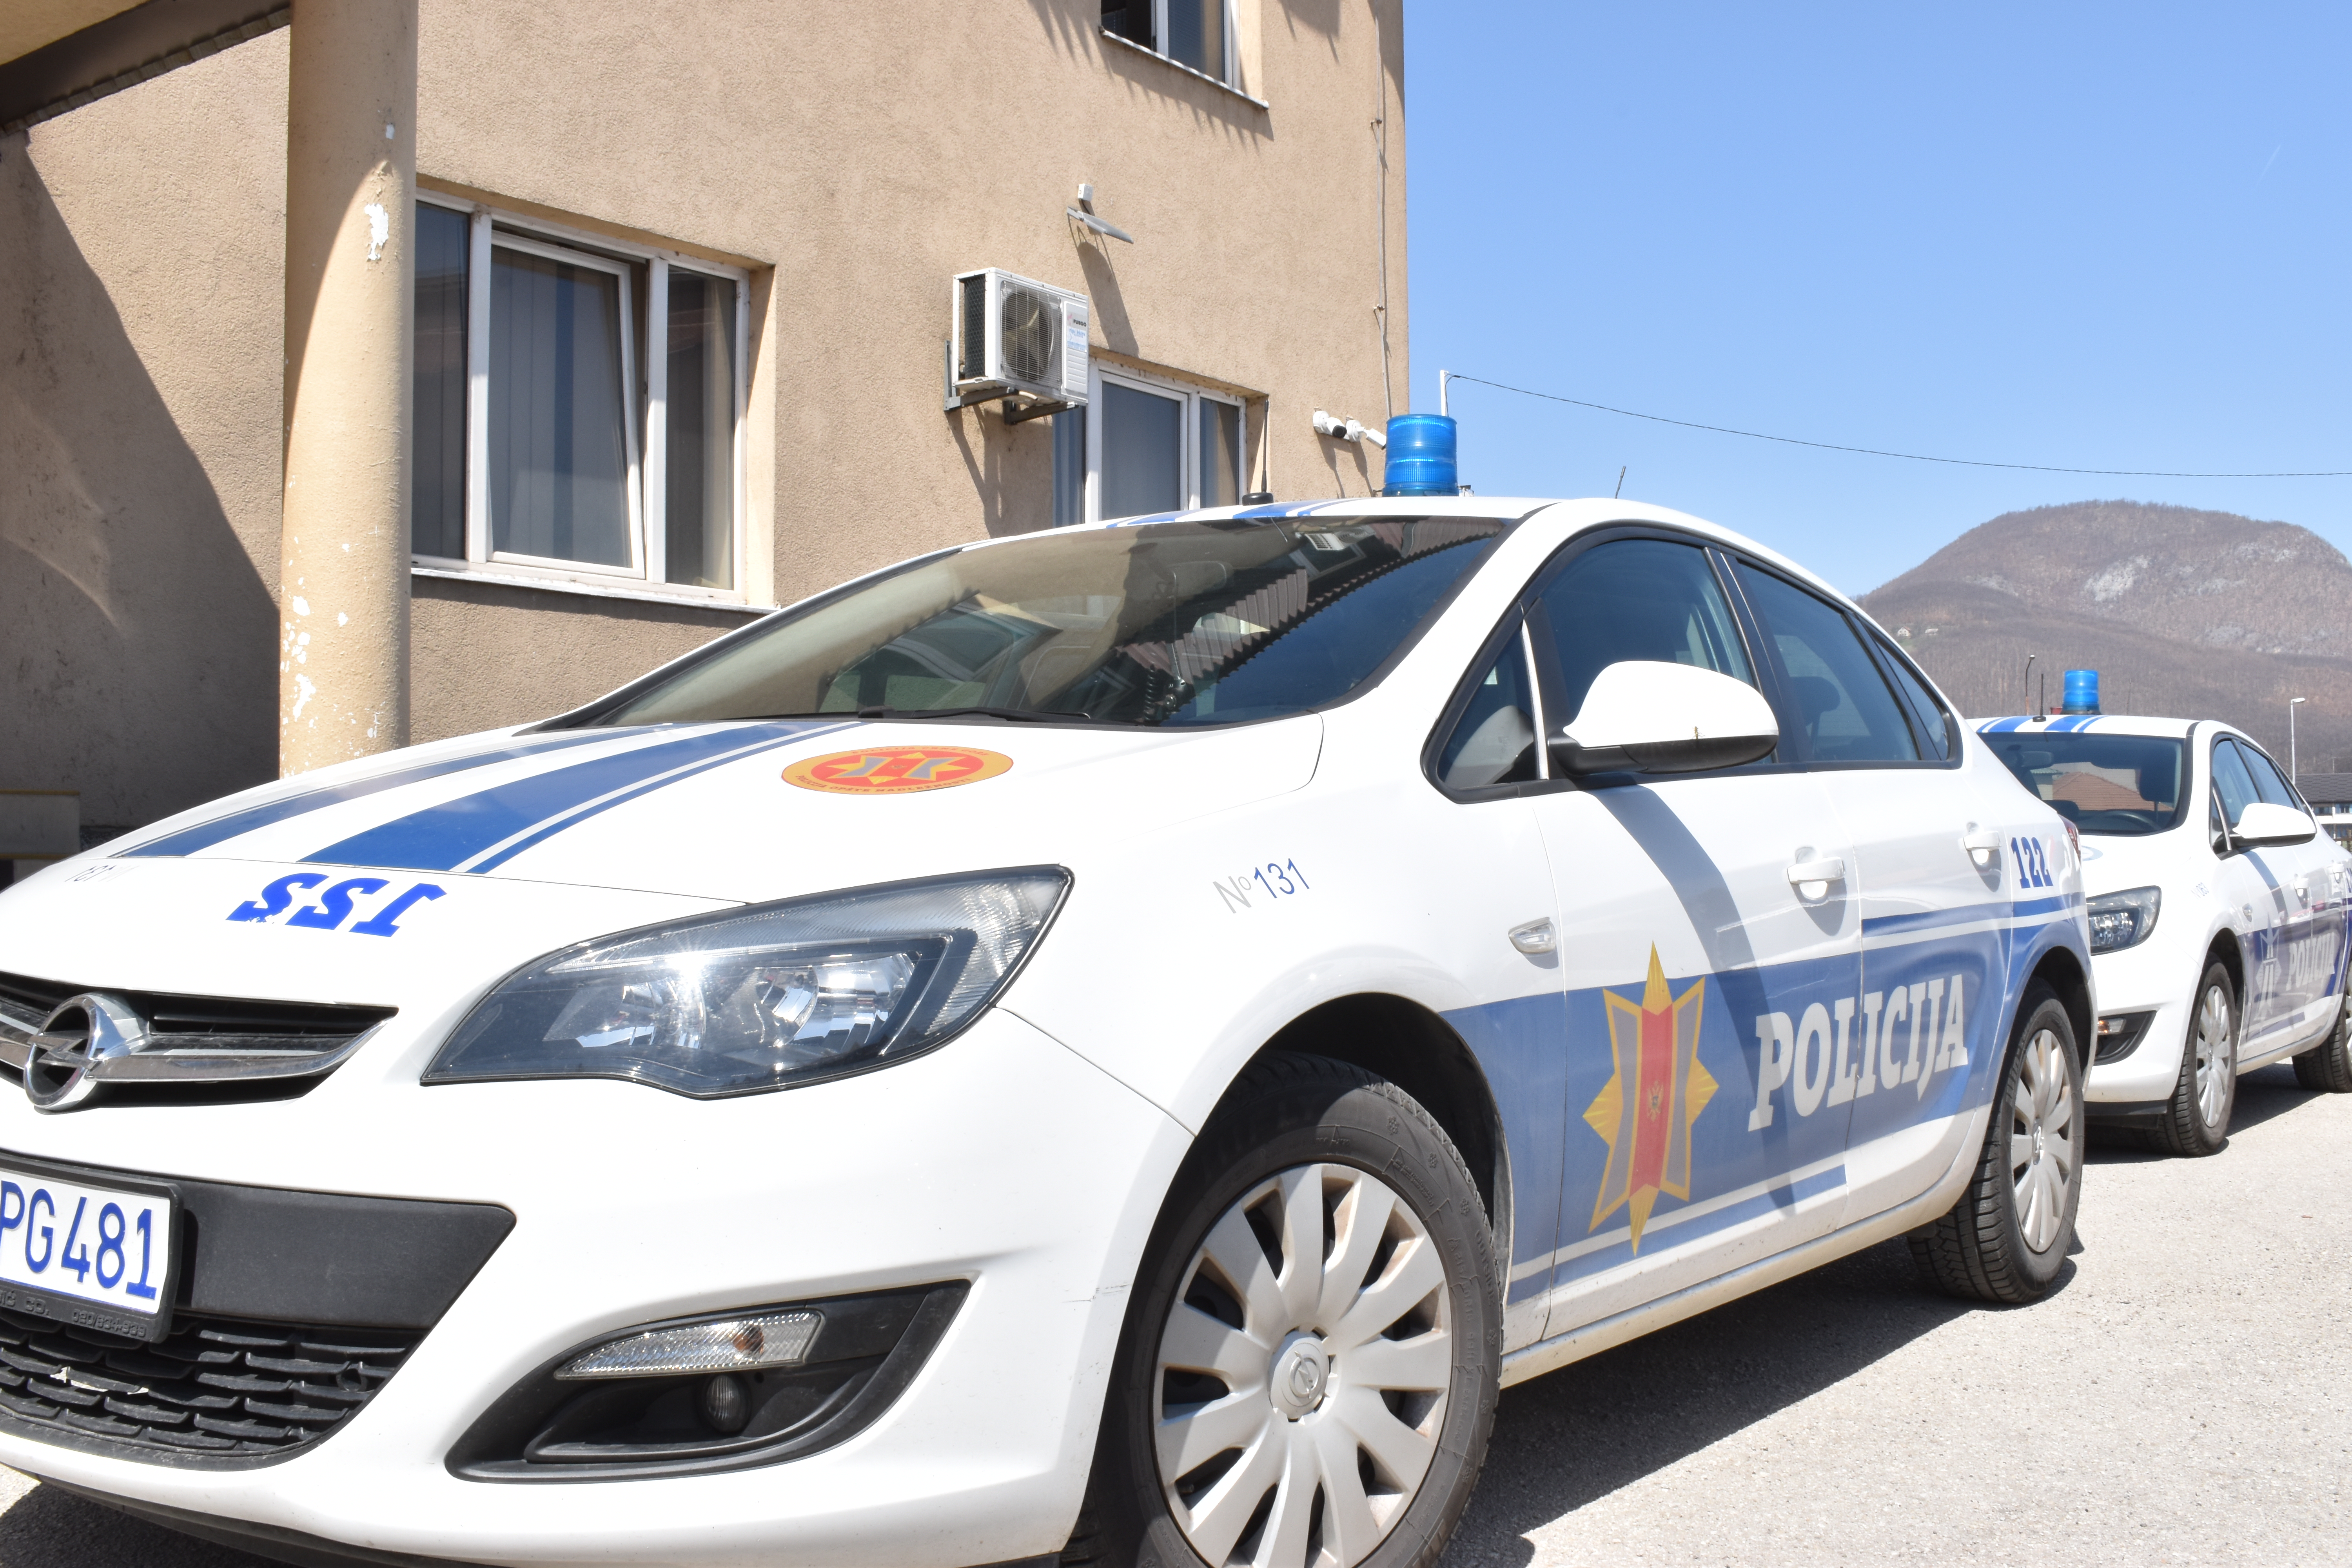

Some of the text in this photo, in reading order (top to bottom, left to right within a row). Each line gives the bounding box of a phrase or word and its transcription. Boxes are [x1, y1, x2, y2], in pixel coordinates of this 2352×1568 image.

[2010, 837, 2054, 889] 122
[2285, 932, 2335, 991] POLICIJA
[1748, 974, 1968, 1132] POLICIJA
